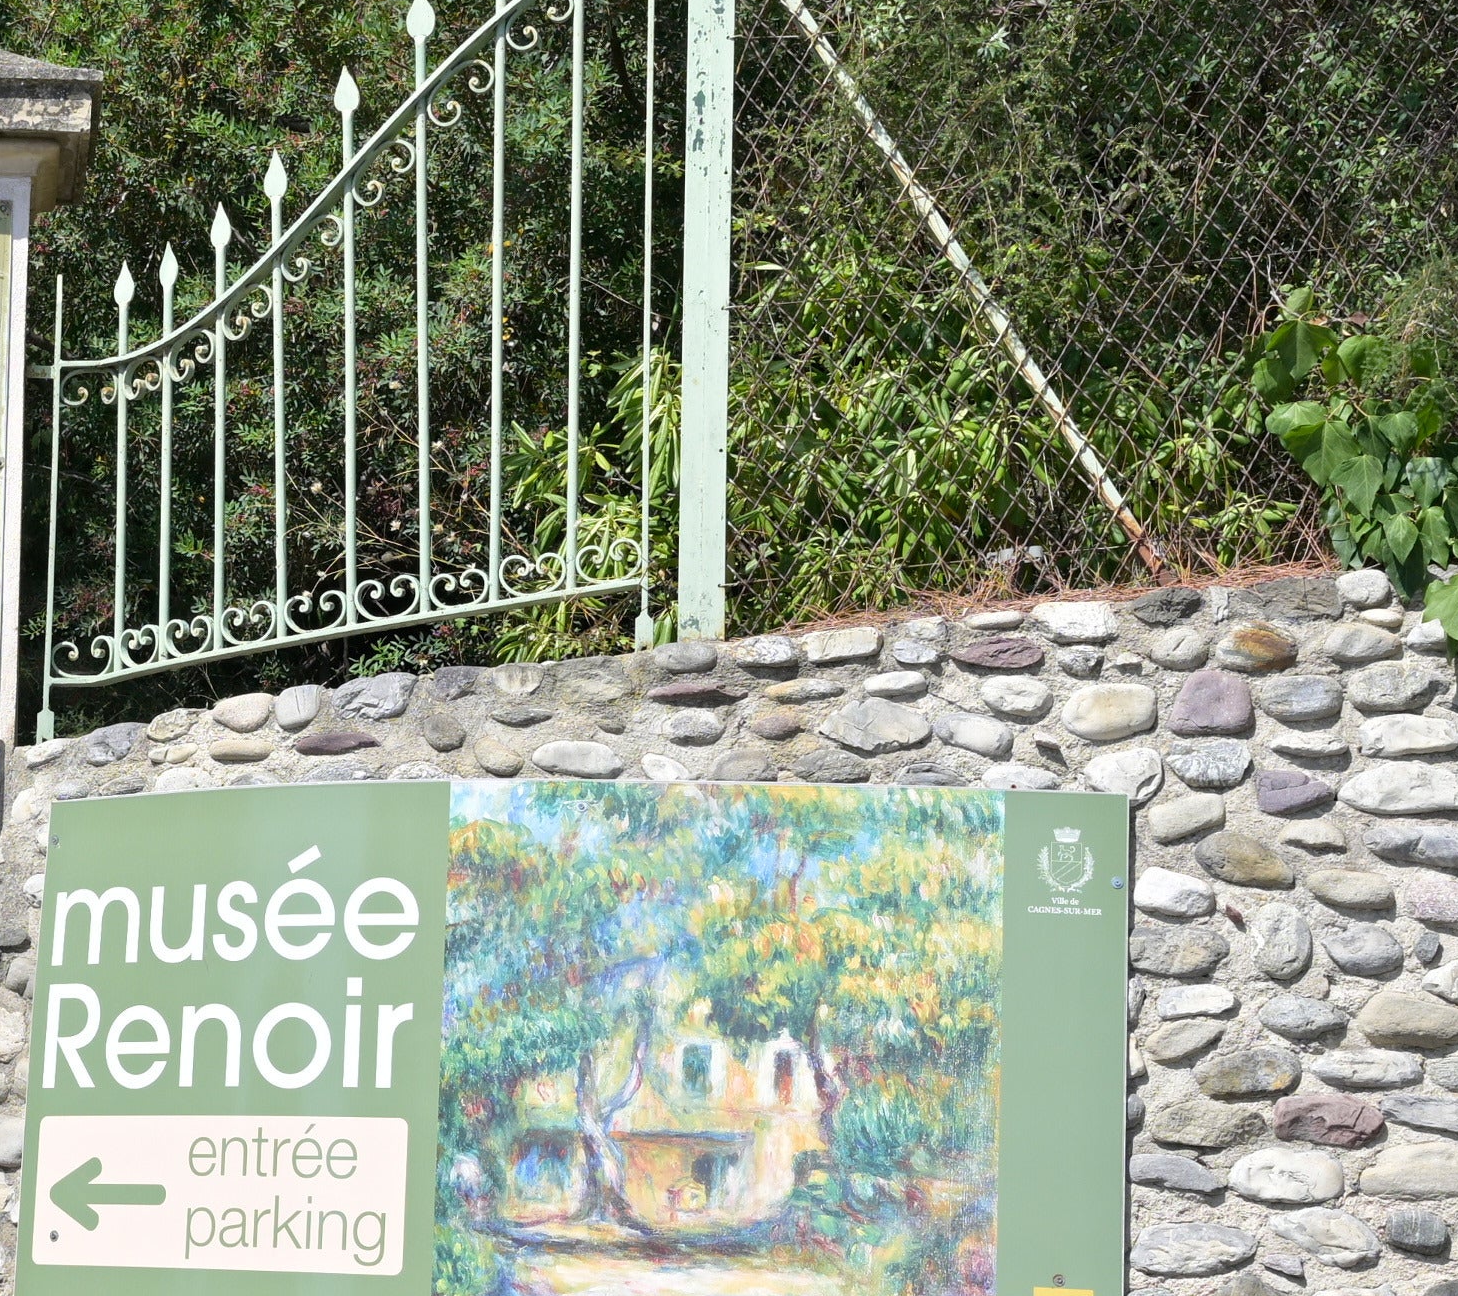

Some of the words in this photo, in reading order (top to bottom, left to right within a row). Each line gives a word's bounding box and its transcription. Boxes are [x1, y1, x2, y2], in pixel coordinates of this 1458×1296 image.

[51, 844, 419, 966] musée
[1027, 905, 1102, 916] CAGNES-SUR-MER
[1051, 897, 1068, 905] Ville
[1069, 897, 1080, 905] de
[42, 977, 414, 1089] Renoir
[188, 1124, 358, 1180] entrée
[184, 1195, 387, 1266] parking
